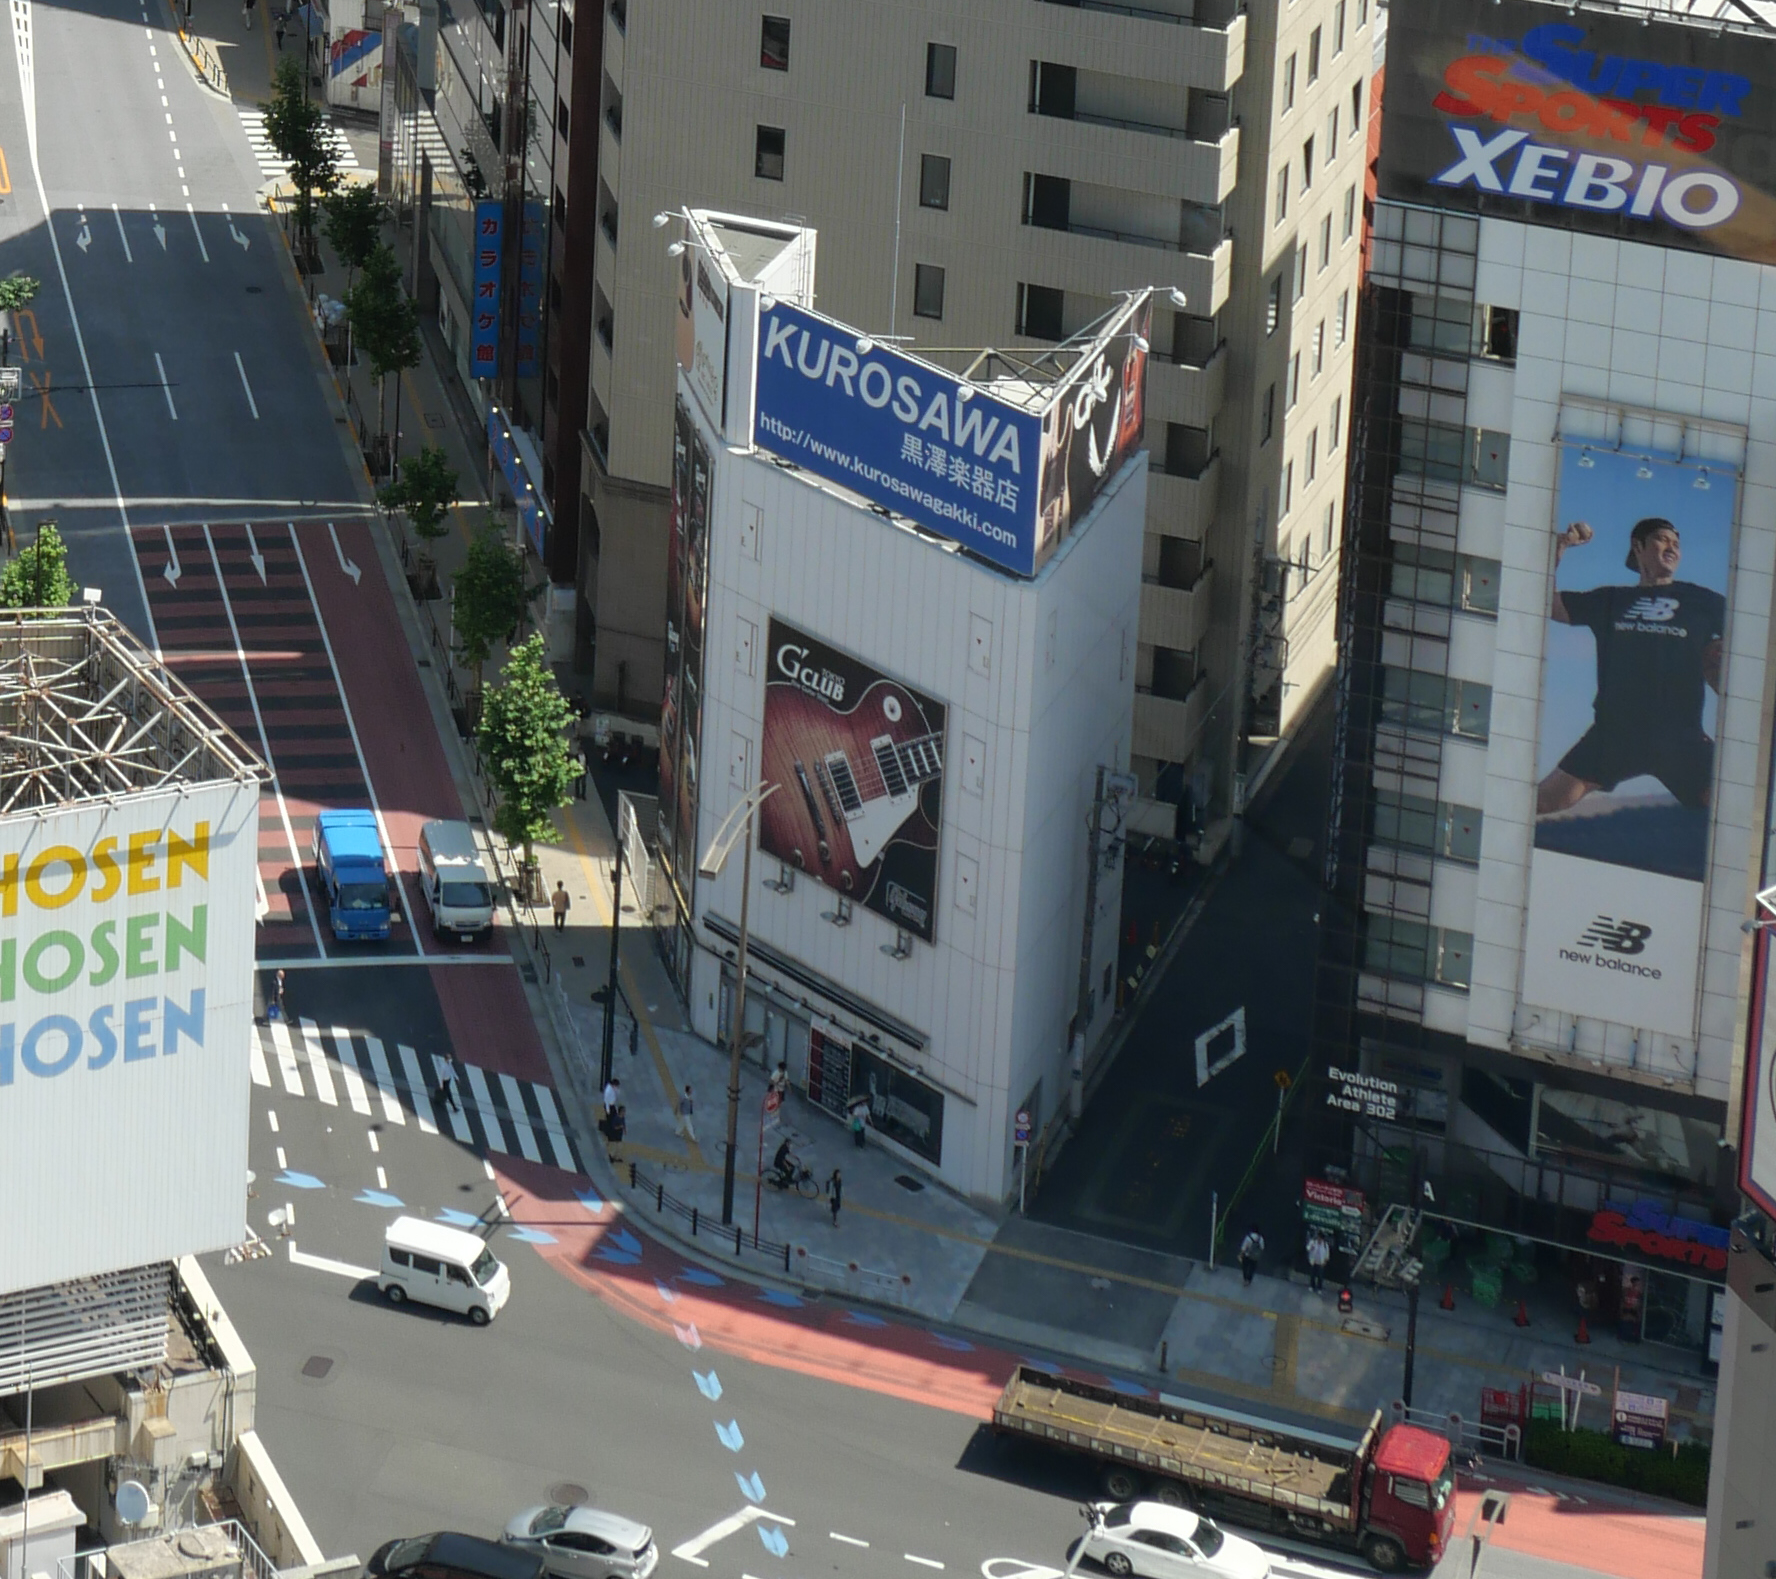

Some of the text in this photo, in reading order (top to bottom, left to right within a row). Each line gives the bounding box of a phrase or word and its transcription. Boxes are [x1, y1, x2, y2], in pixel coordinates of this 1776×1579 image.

[1432, 54, 1722, 155] SPORTS
[1509, 22, 1753, 118] SUPER
[1431, 125, 1740, 229] XEBIO
[477, 217, 498, 362] カラオケ館
[764, 316, 1021, 475] KUROSAWA
[760, 411, 1018, 549] http://www.kurosawagakki.com
[899, 432, 1020, 514] 黒澤楽器店
[1614, 621, 1688, 638] new balance
[1559, 948, 1662, 980] new balance
[1326, 1094, 1396, 1121] Area 302
[1328, 1066, 1398, 1094] Evolution
[1342, 1084, 1397, 1108] Athlete
